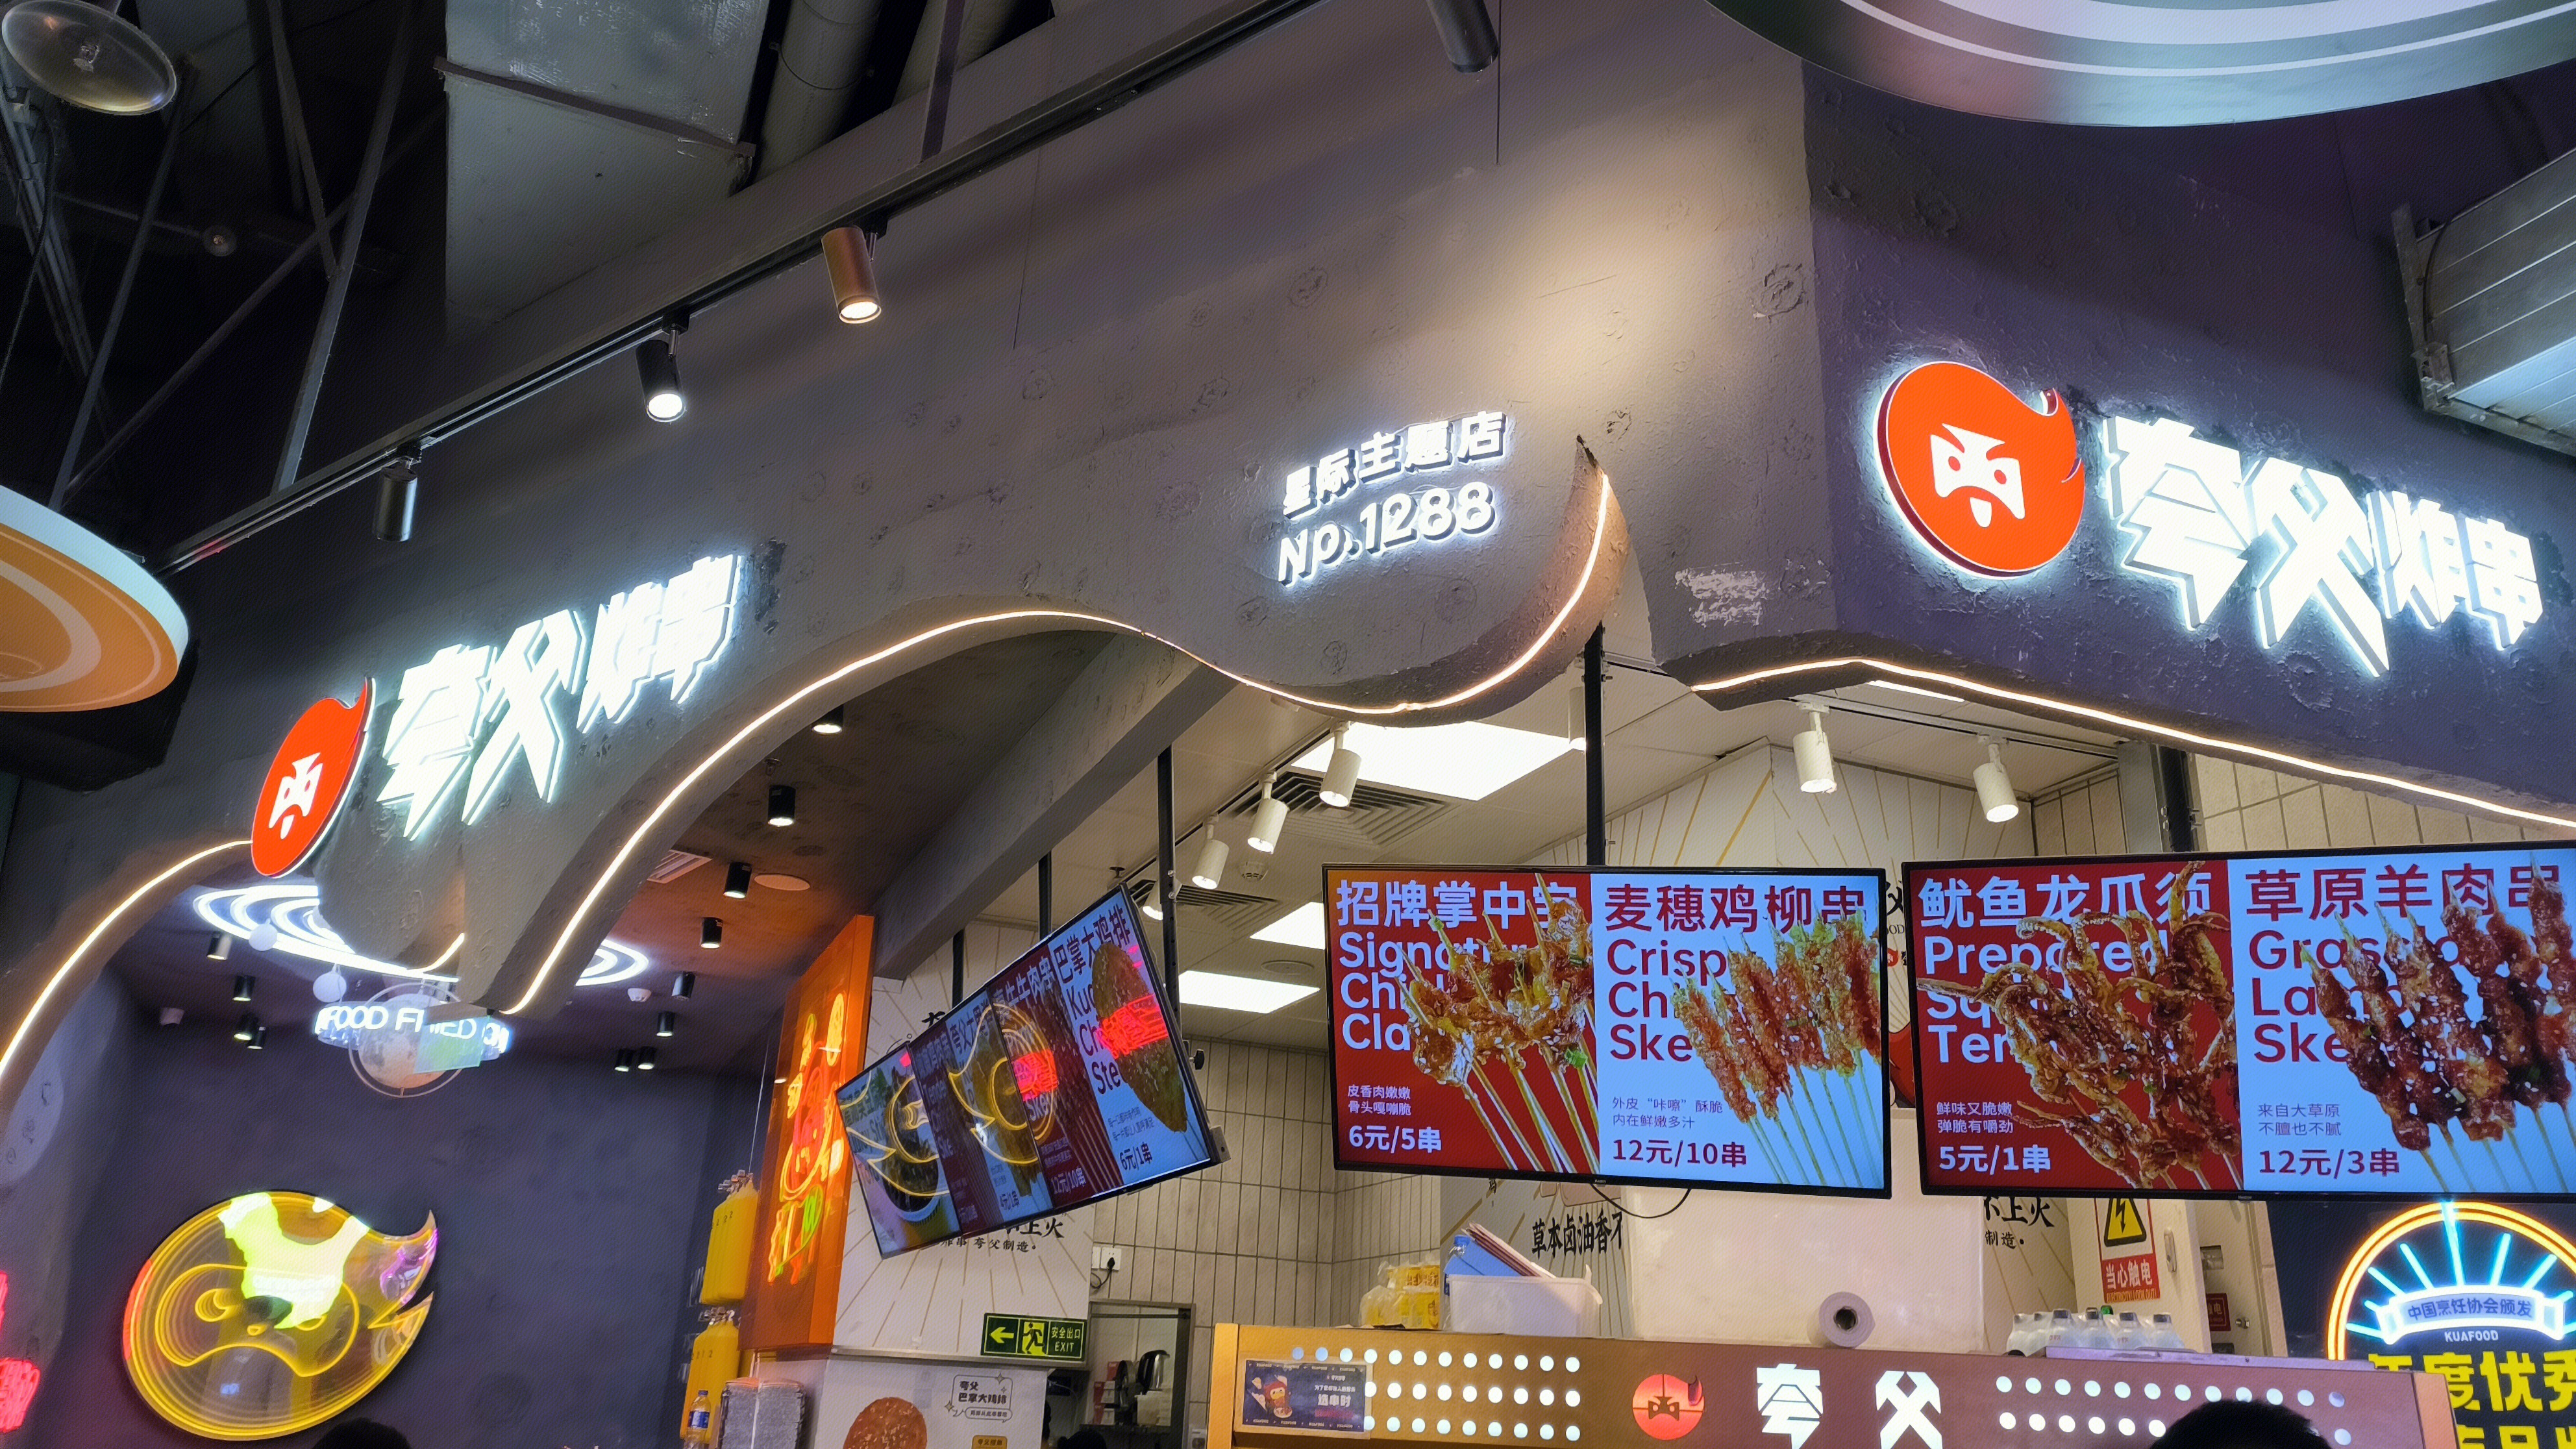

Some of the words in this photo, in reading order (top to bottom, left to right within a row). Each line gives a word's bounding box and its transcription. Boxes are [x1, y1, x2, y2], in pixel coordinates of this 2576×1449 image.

[2102, 415, 2544, 678] 夸父炸串
[377, 553, 744, 841] 夸父炸串
[1607, 939, 1757, 986] Crisp
[1613, 1113, 1695, 1130] 内在鲜嫩多汁
[1937, 1102, 2012, 1116] 鲜味又脆嫩
[2258, 1103, 2340, 1118] 来自大草原
[1349, 1124, 1443, 1154] 6元/5串
[1613, 1139, 1747, 1169] 12元/10串
[1119, 1141, 1154, 1172] 6元/1串
[1939, 1144, 2051, 1175] 5元/1串
[2259, 1147, 2400, 1179] 12元/3串
[1006, 1217, 1065, 1239] 上火
[2105, 1258, 2153, 1290] 当心触电
[2408, 1298, 2533, 1320] 中国烹饪协会颁发
[1051, 1326, 1081, 1339] 安全出口
[1054, 1341, 1074, 1353] EXIT
[2444, 1330, 2499, 1343] KUAFOOD
